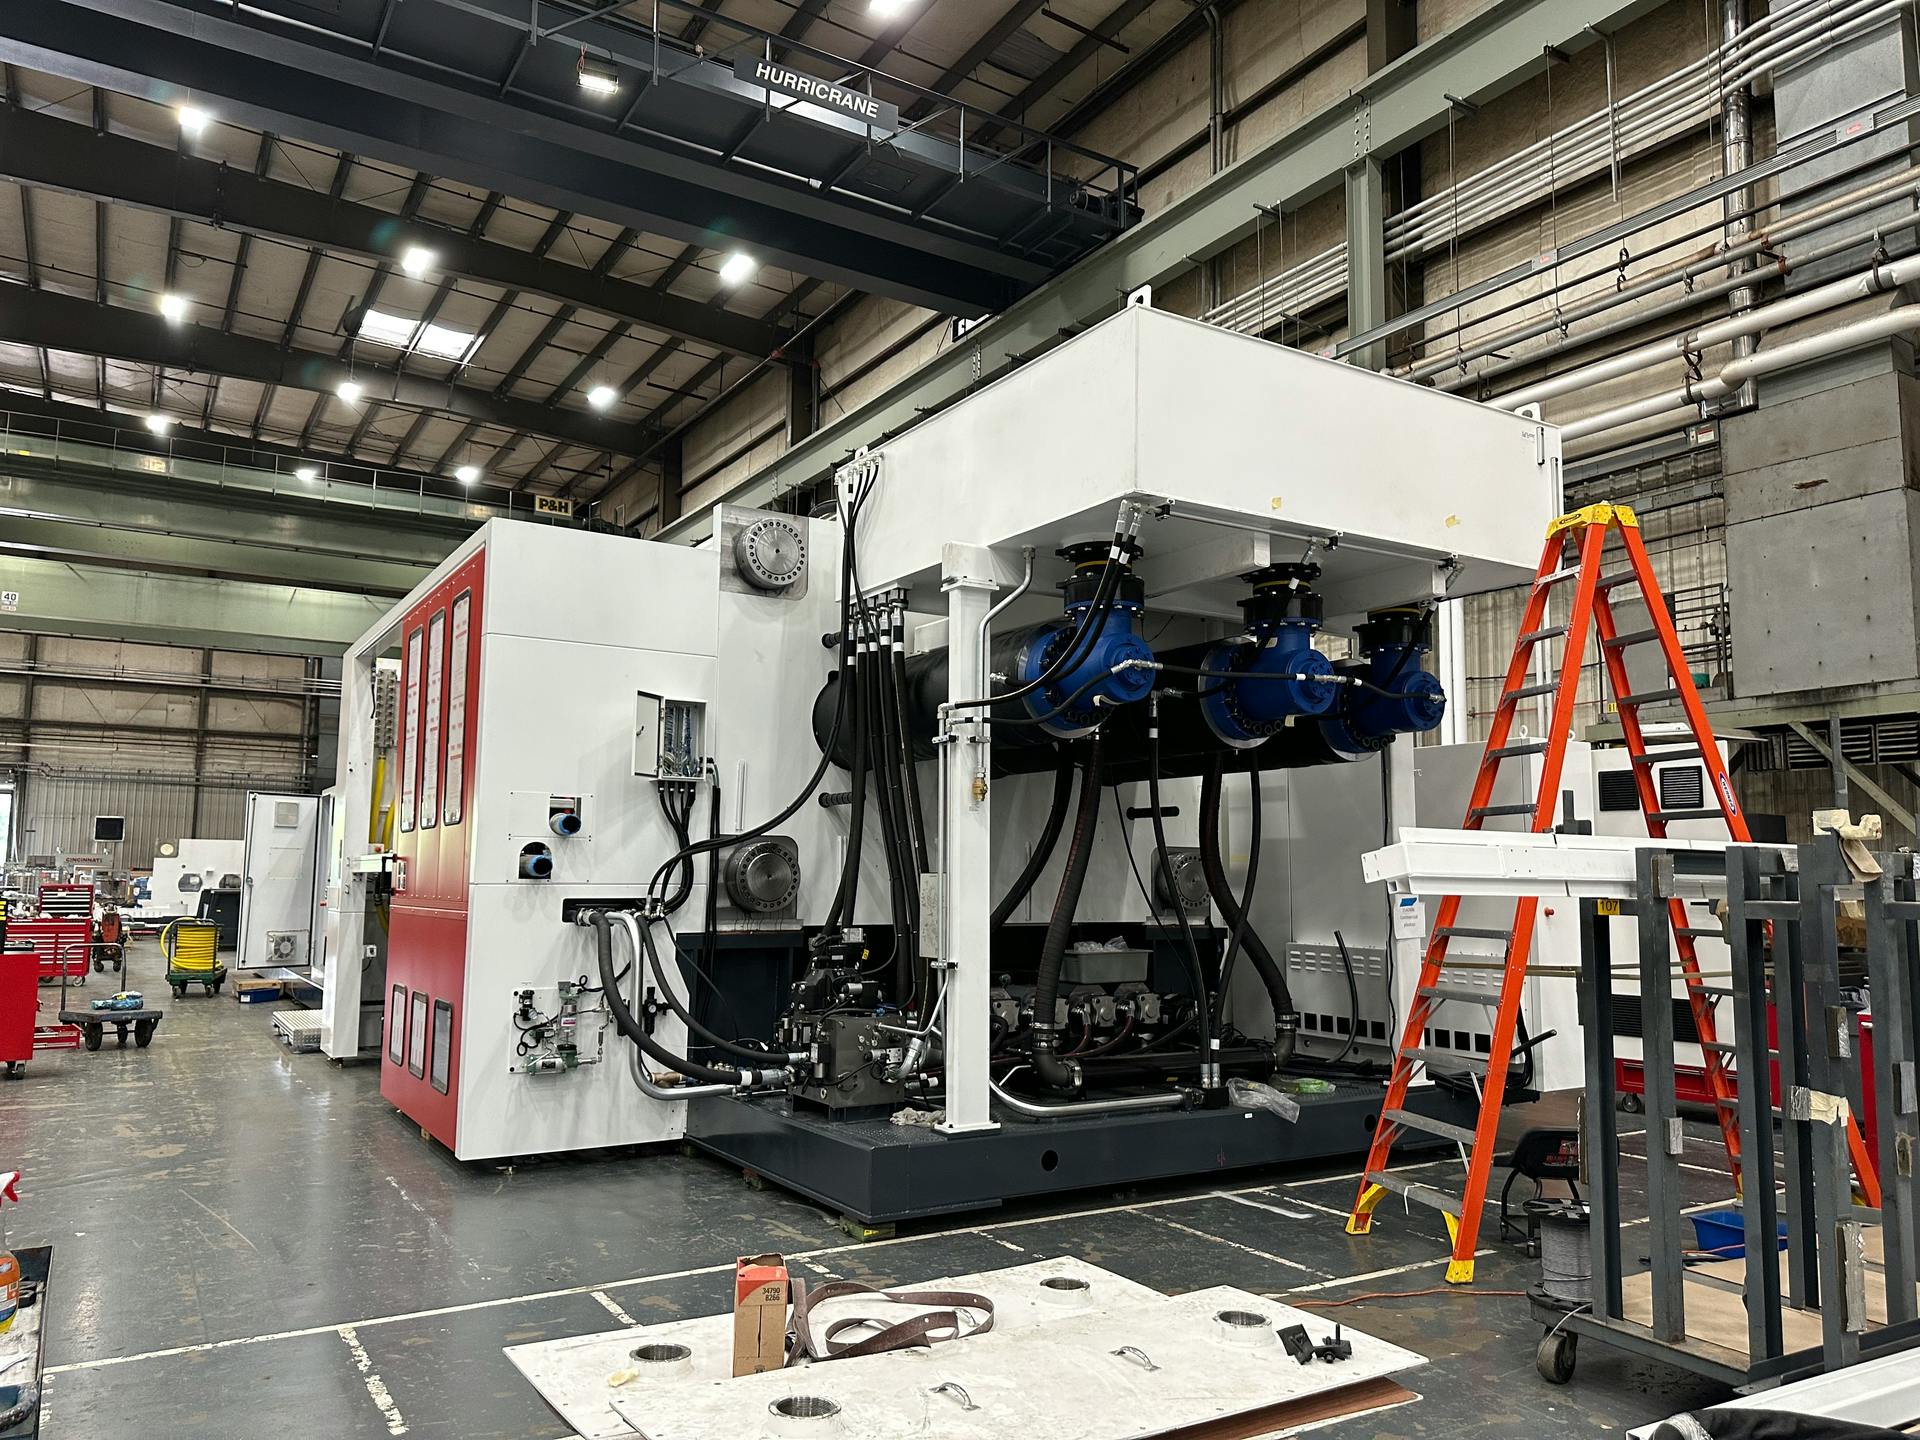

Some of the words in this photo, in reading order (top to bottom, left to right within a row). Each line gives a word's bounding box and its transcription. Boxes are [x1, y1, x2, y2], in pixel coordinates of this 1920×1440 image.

[755, 62, 880, 119] HURRICRANE
[539, 498, 569, 514] P&H
[4, 592, 17, 601] 40
[1600, 900, 1618, 911] 107
[762, 1287, 781, 1295] 34790
